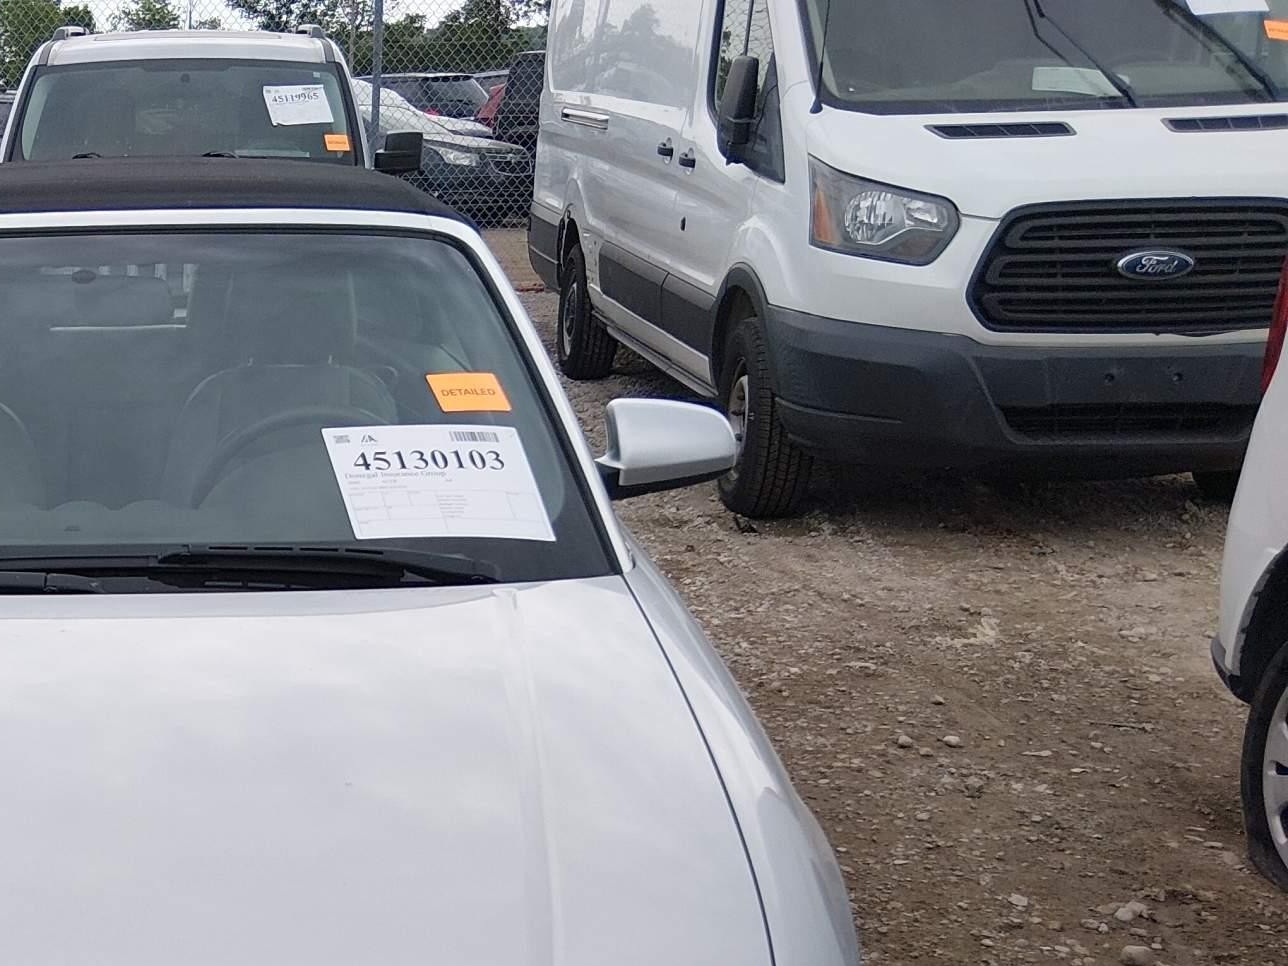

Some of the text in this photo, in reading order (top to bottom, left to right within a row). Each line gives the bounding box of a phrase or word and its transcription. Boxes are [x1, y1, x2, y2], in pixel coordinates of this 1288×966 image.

[272, 92, 320, 103] 45119965
[1135, 256, 1178, 273] Ford
[441, 388, 496, 397] DETAILED
[353, 449, 505, 471] 45130103
